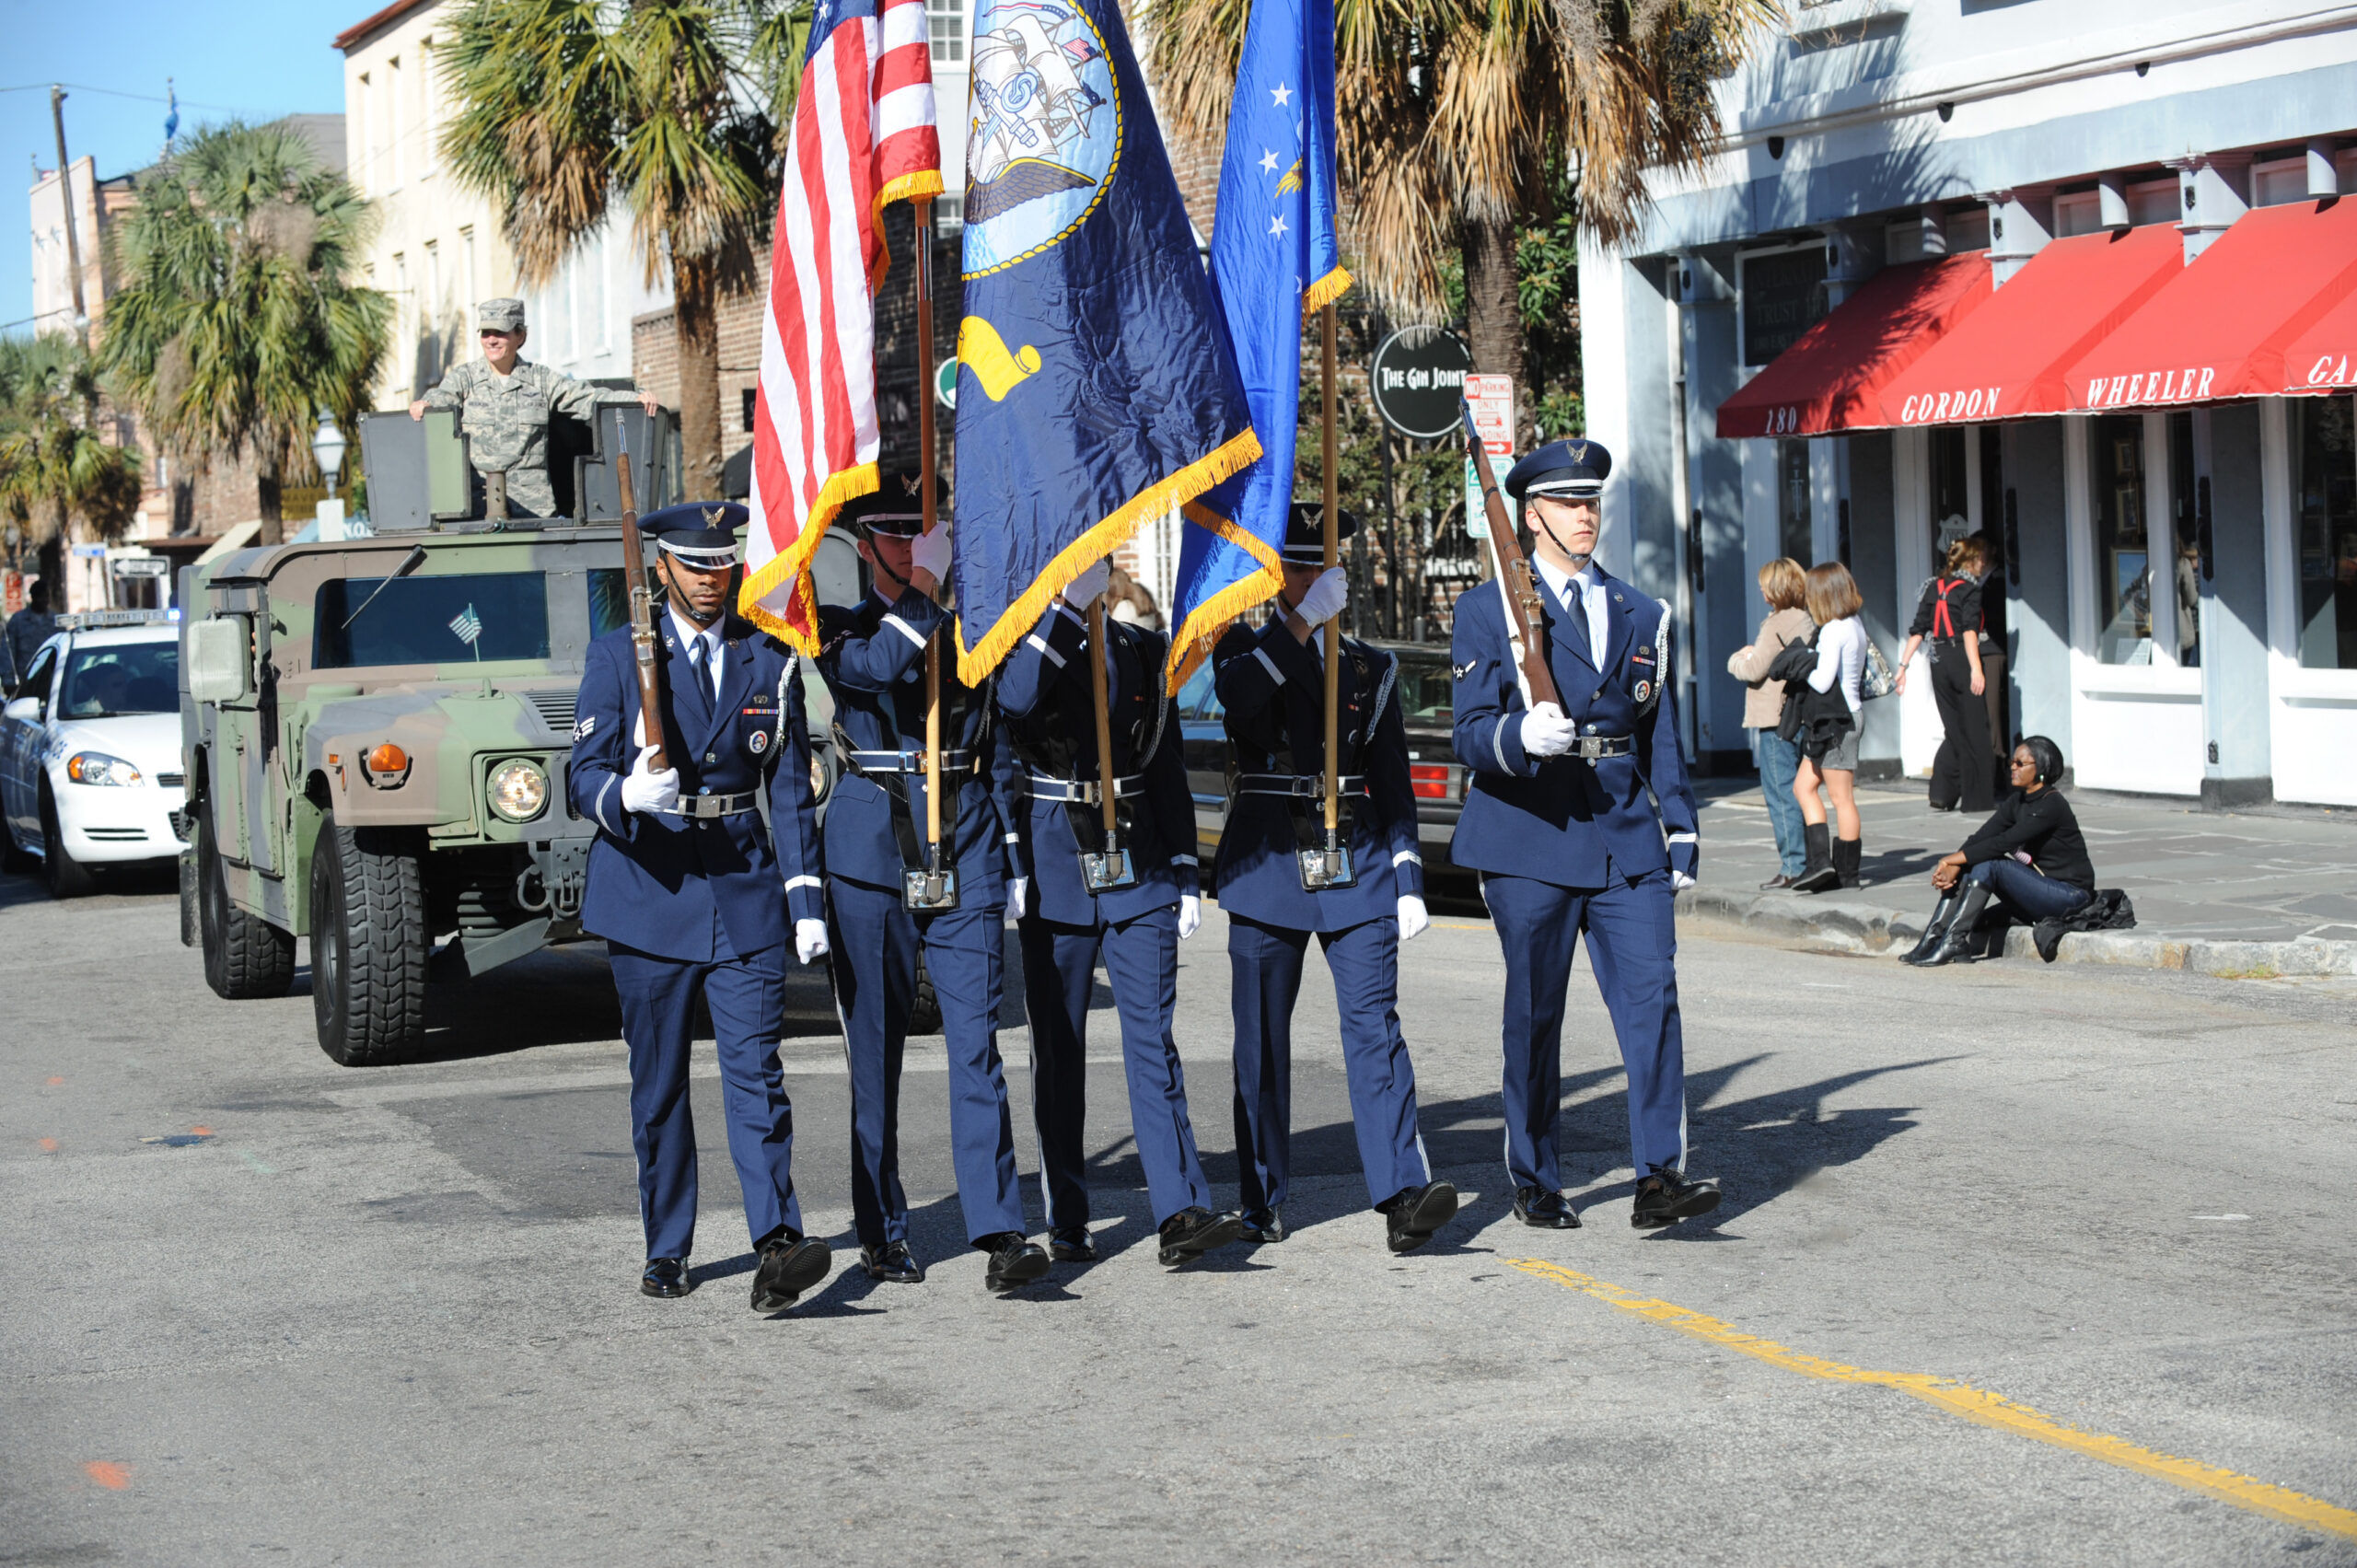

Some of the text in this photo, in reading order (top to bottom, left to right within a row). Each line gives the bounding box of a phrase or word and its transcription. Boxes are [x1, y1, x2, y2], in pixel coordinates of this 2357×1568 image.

[1466, 380, 1510, 396] NO PARKING
[1901, 354, 2357, 423] GORDON WHEELER GA
[1478, 398, 1499, 411] ONLY
[1765, 406, 1797, 434] 180
[1477, 429, 1508, 441] OADING
